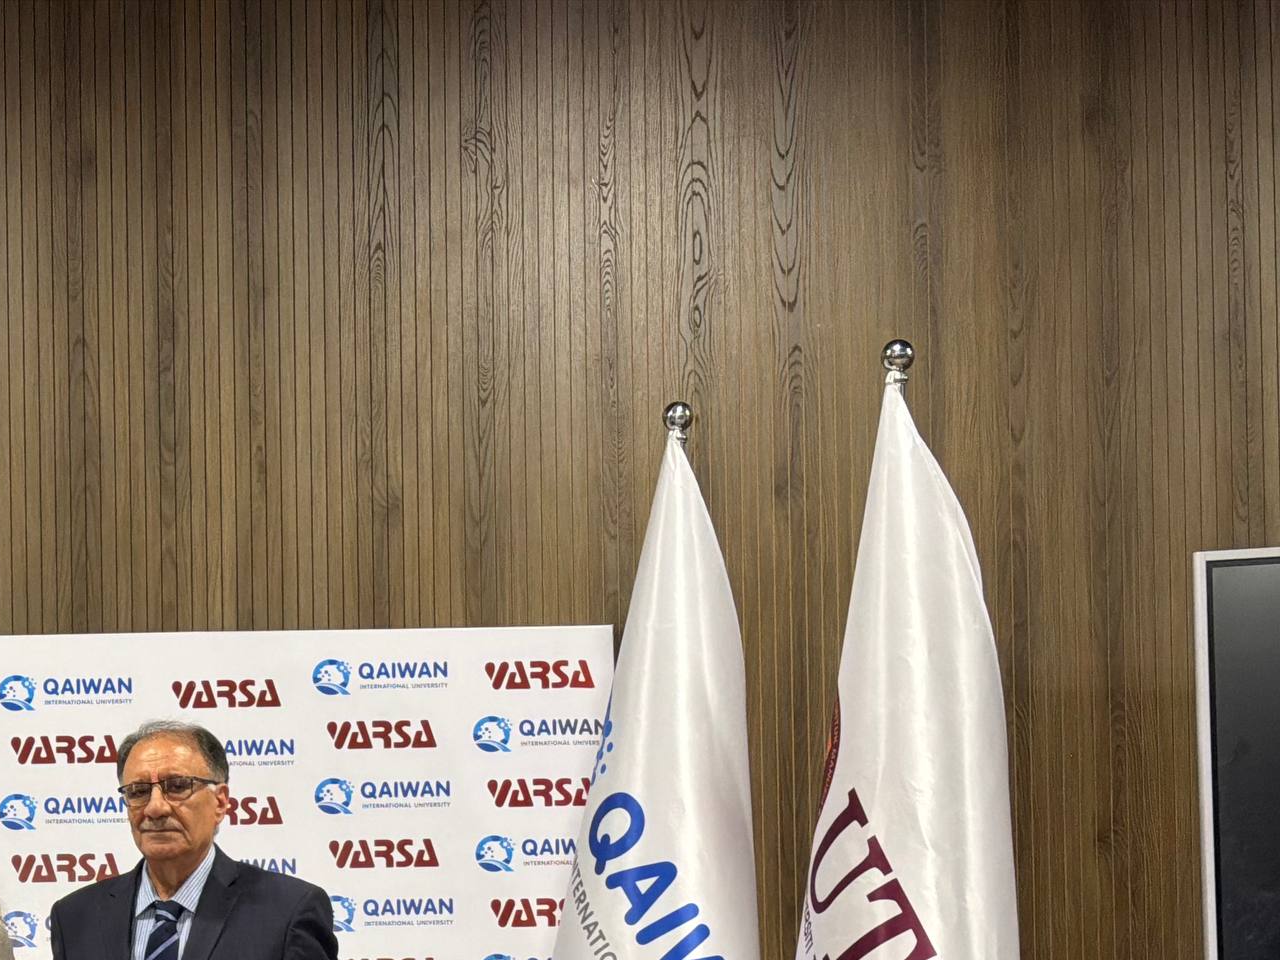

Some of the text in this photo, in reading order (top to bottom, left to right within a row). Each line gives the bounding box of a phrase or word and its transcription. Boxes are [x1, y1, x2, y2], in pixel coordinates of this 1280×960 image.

[358, 662, 448, 679] QAIWAN
[485, 660, 595, 690] VARSA
[43, 677, 132, 695] QAIWAN
[172, 679, 281, 709] VARSA
[327, 720, 437, 749] VARSA
[519, 719, 604, 736] QAIWAN
[11, 735, 118, 765] VARSA
[225, 739, 294, 755] AIWAN
[360, 781, 450, 798] QAIWAN
[225, 796, 283, 826] RSA
[329, 839, 439, 869] VARSA
[522, 839, 576, 856] QAIW
[12, 853, 119, 883] VARSA
[363, 898, 453, 915] QAIWAN
[491, 898, 565, 927] VAR
